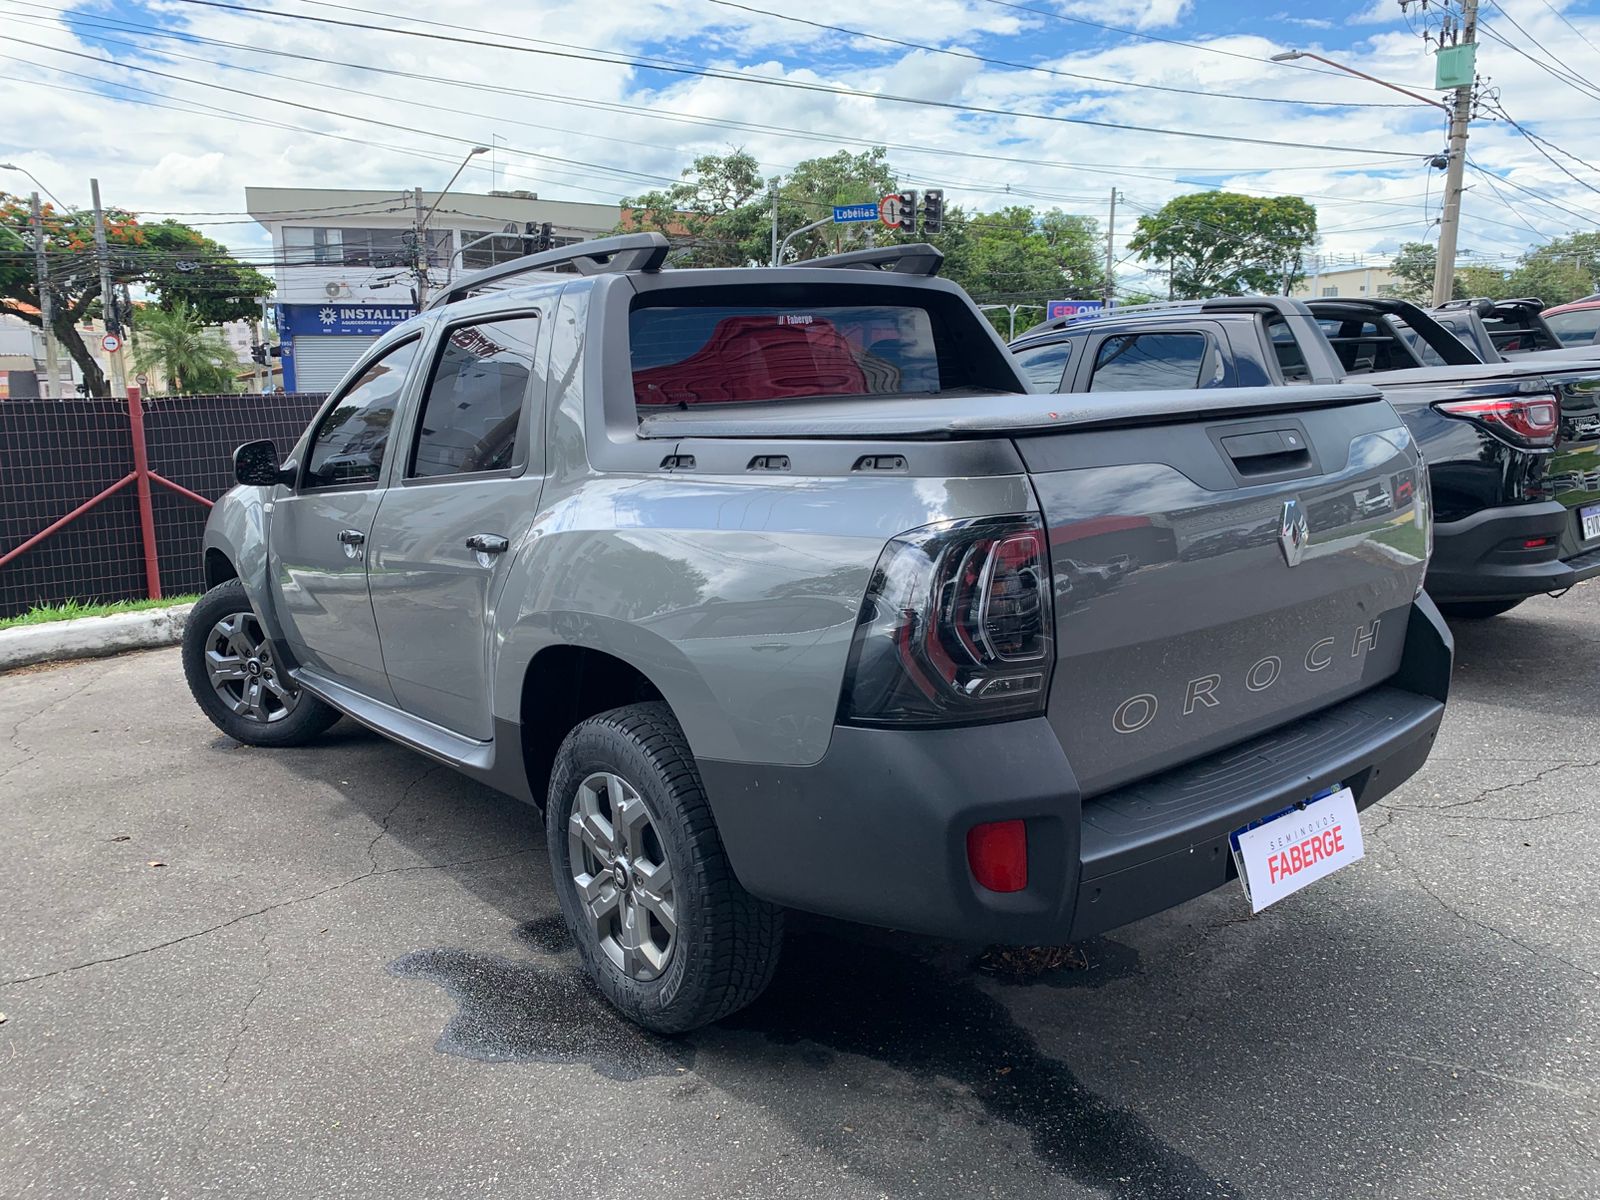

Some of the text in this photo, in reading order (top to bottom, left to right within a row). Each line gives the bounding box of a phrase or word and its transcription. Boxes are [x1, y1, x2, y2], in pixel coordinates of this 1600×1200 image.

[1112, 620, 1381, 734] OROCH
[1267, 825, 1345, 884] FABERGE
[1269, 813, 1336, 851] SEMINOVOS
